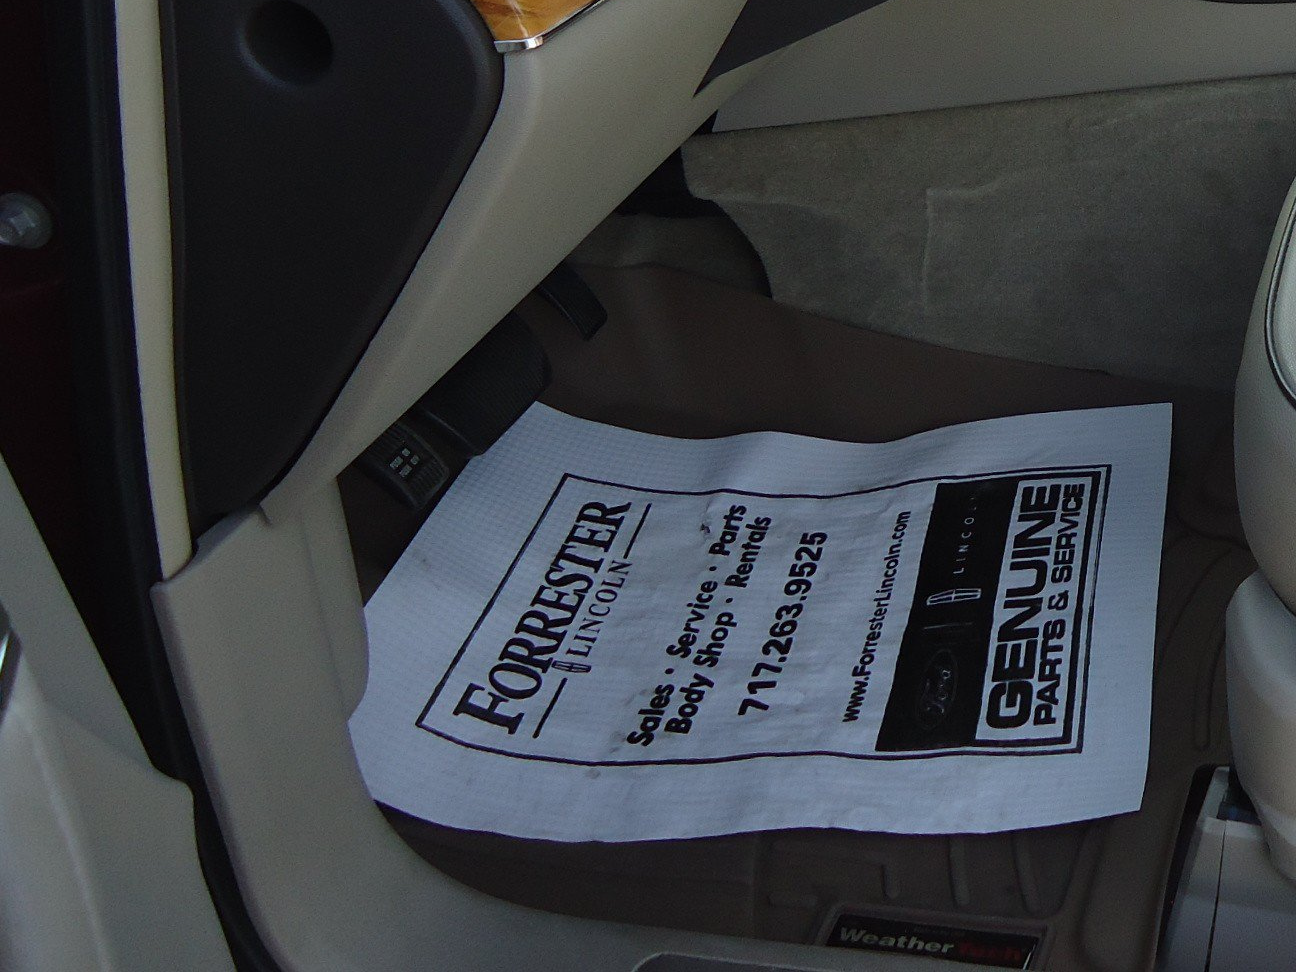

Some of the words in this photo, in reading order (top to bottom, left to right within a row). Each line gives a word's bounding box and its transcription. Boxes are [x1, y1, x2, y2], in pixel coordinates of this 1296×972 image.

[452, 501, 632, 735] FORRESTER
[566, 560, 633, 657] LINCOLN
[626, 684, 675, 746] Sales
[666, 580, 718, 658] Service
[708, 504, 747, 556] Parts
[664, 673, 715, 734] Body
[692, 611, 737, 668] Shop
[725, 516, 772, 588] Rentals
[737, 531, 828, 716] 717.263.9525
[842, 510, 912, 722] www.ForresterLincoln.com
[952, 495, 978, 575] LINCO
[985, 484, 1061, 729] GENUINE
[1048, 589, 1069, 611] &
[1051, 483, 1086, 584] SERVICE
[1033, 618, 1066, 726] PARTS
